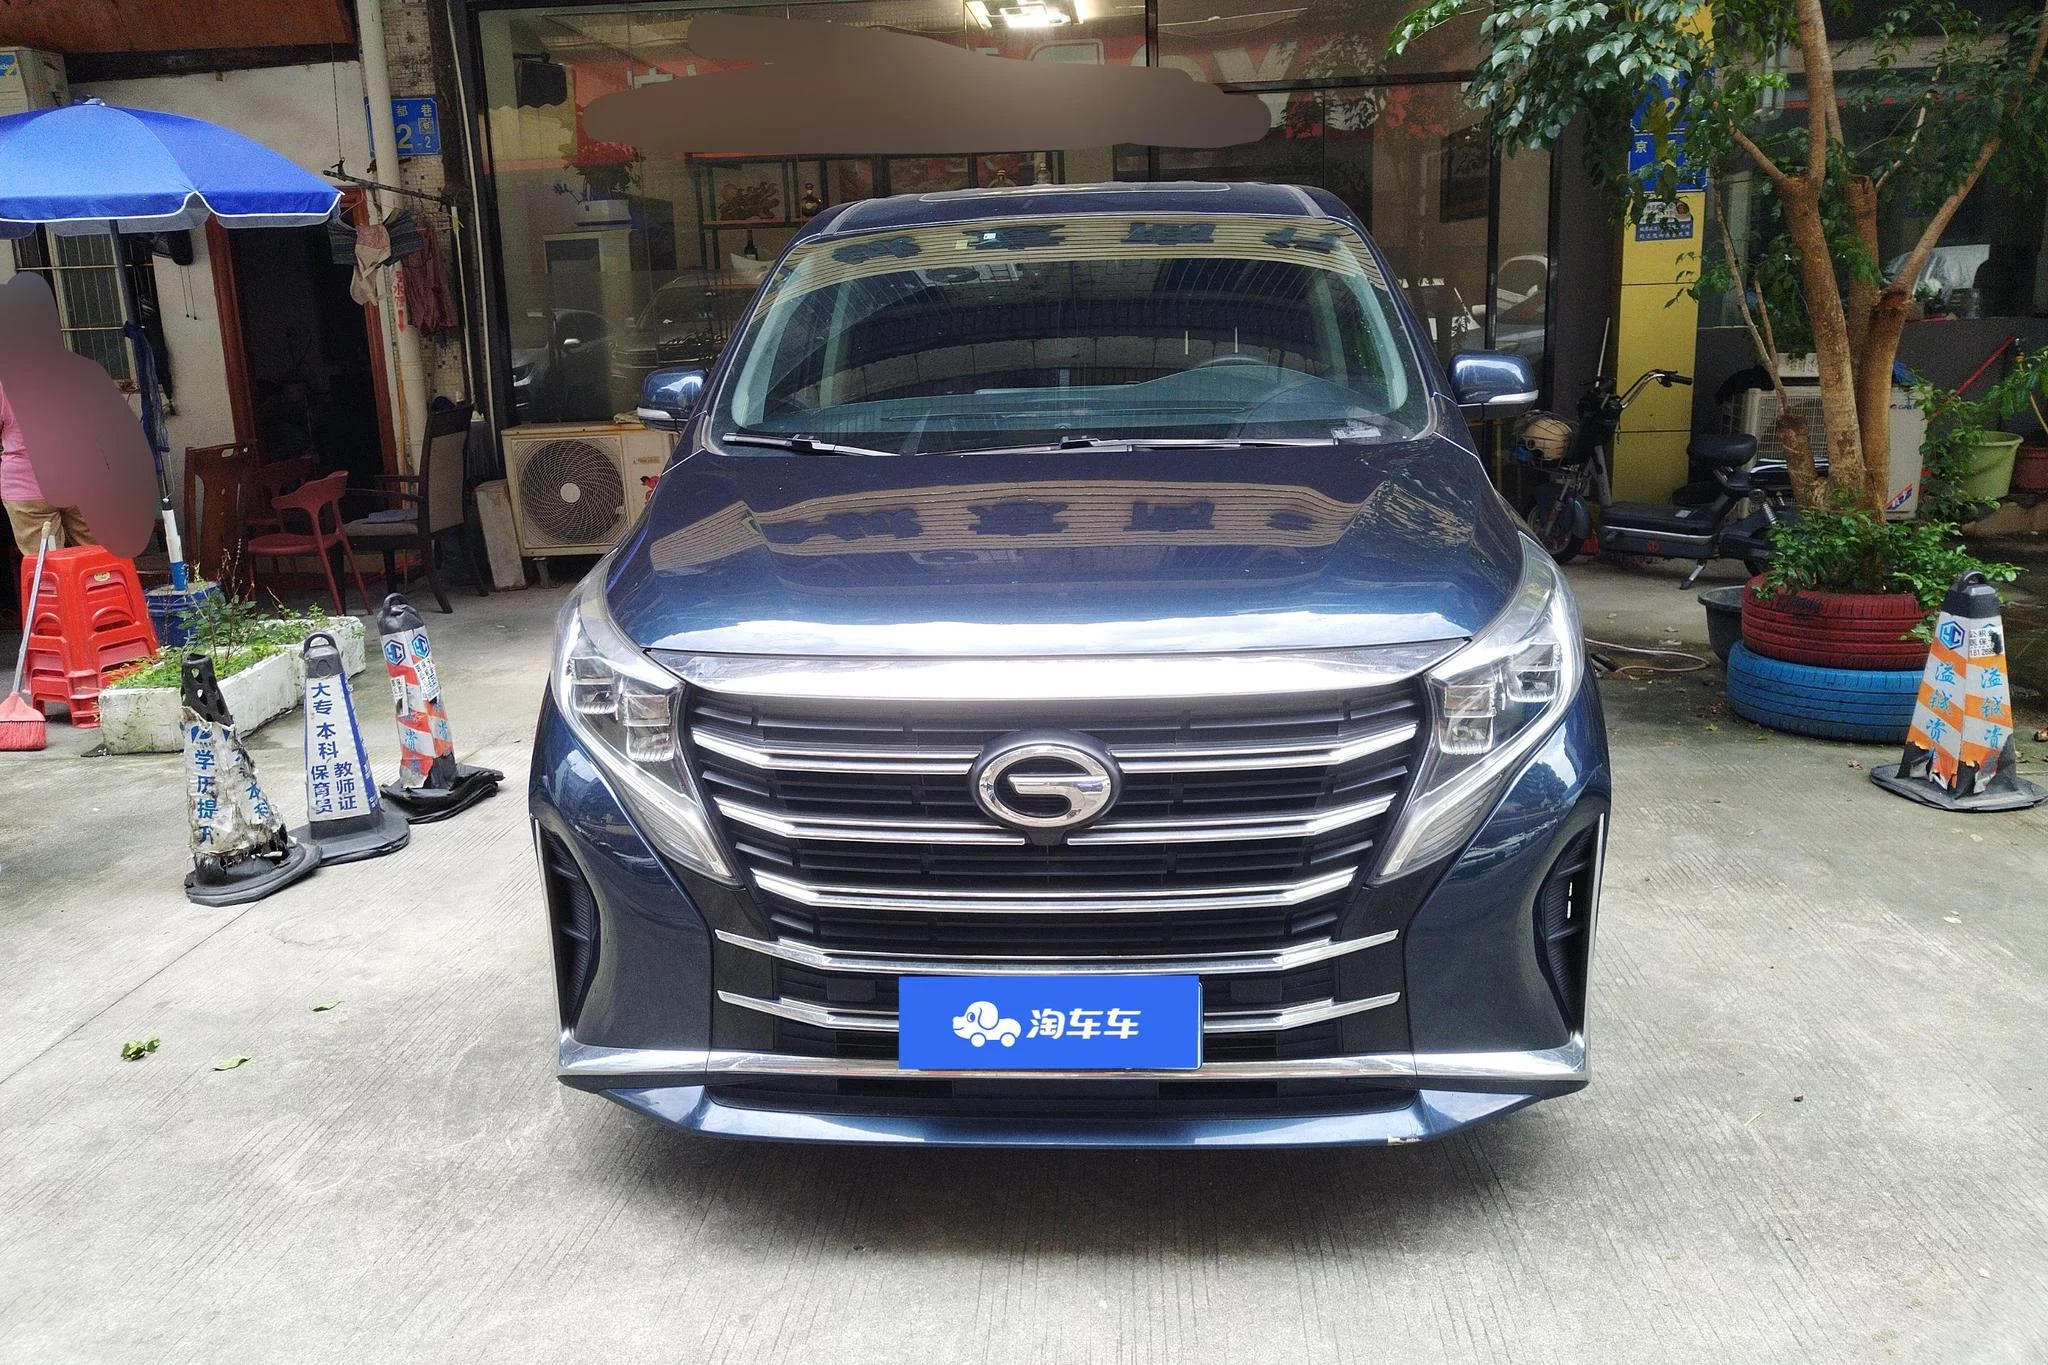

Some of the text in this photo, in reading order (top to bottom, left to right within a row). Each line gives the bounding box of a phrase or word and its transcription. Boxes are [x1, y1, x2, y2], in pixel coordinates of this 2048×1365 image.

[311, 765, 333, 815] 保育员
[333, 761, 358, 811] 教师证
